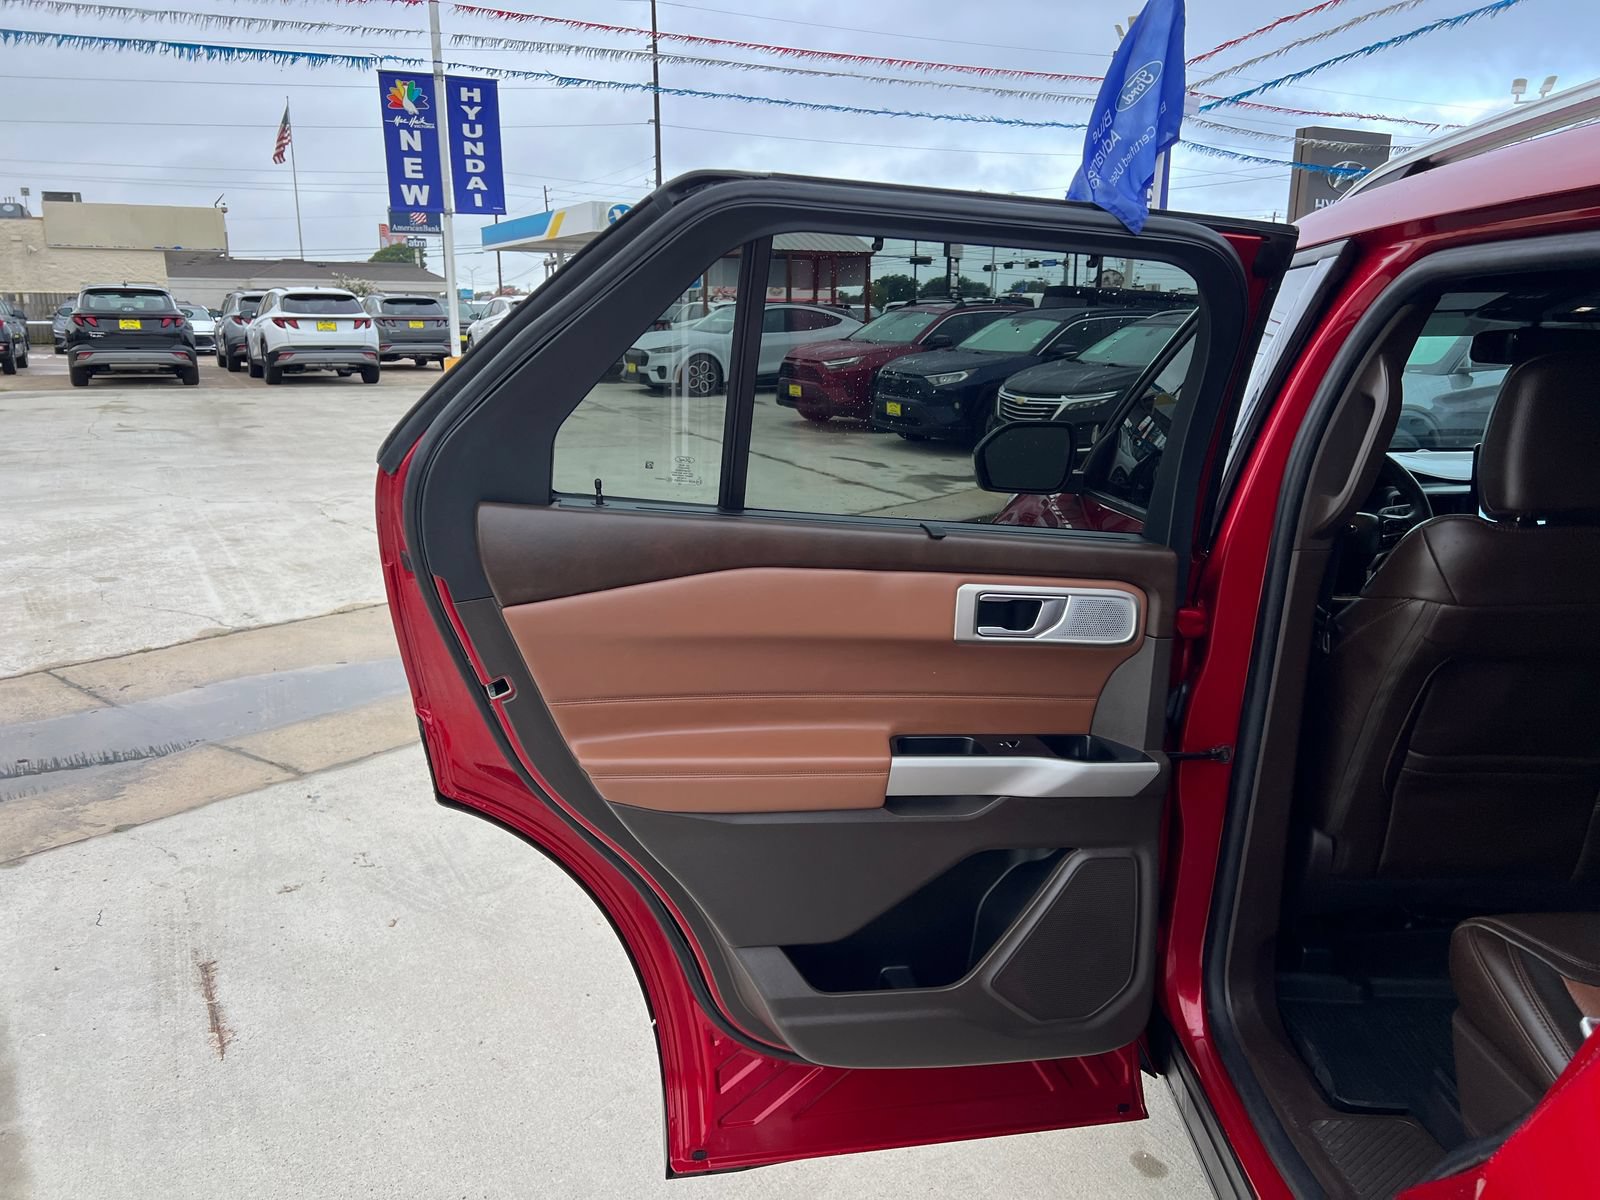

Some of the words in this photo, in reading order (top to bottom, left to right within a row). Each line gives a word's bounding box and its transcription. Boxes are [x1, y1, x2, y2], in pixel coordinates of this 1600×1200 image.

[399, 129, 430, 206] NEW
[460, 87, 488, 207] HYUNDAI
[408, 239, 426, 248] atm
